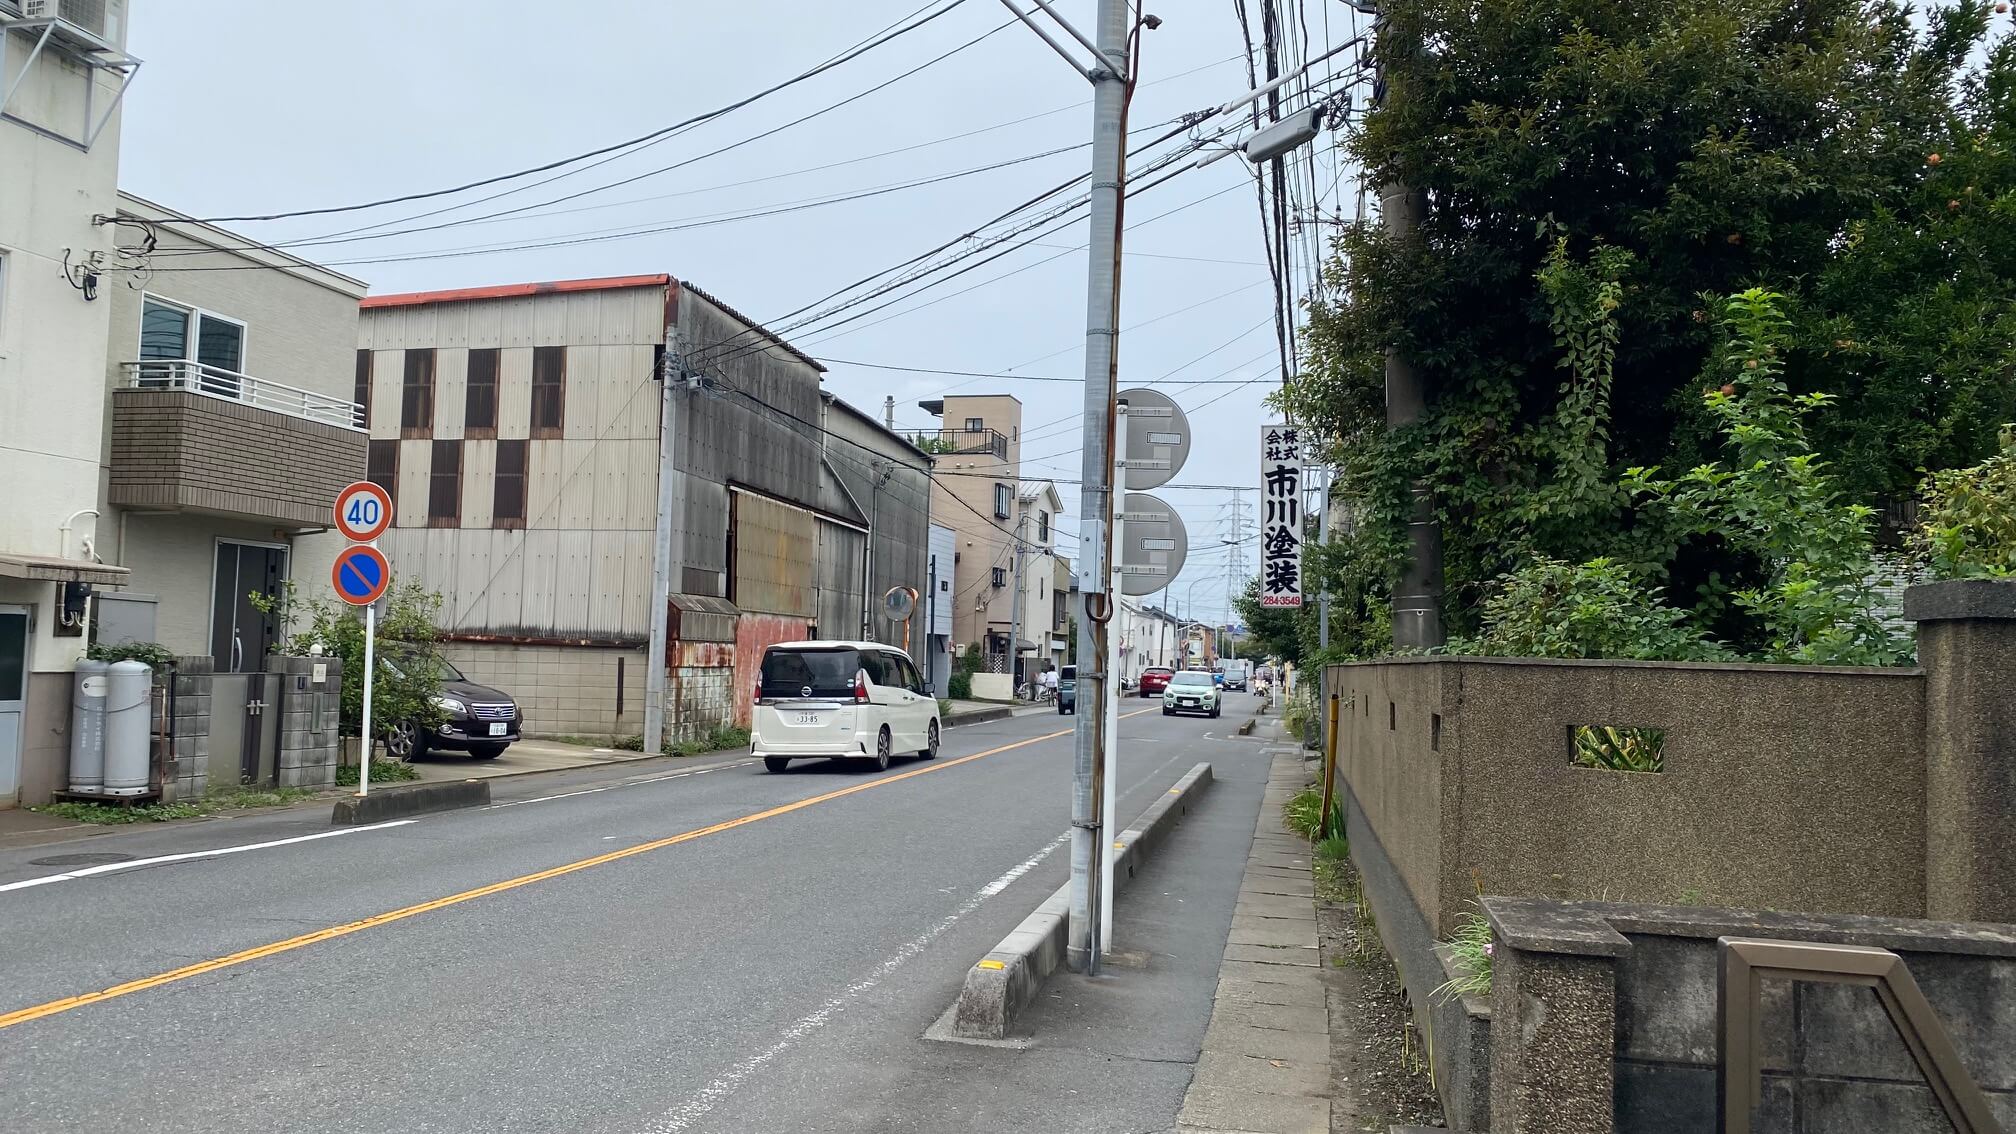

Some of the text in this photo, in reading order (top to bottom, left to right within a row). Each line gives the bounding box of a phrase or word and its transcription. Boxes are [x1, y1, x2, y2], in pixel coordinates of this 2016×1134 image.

[1265, 429, 1283, 461] 会社
[1282, 429, 1299, 461] 株式
[347, 499, 378, 525] 40
[1264, 464, 1300, 595] 市川塗装
[1263, 595, 1300, 605] 284-3549
